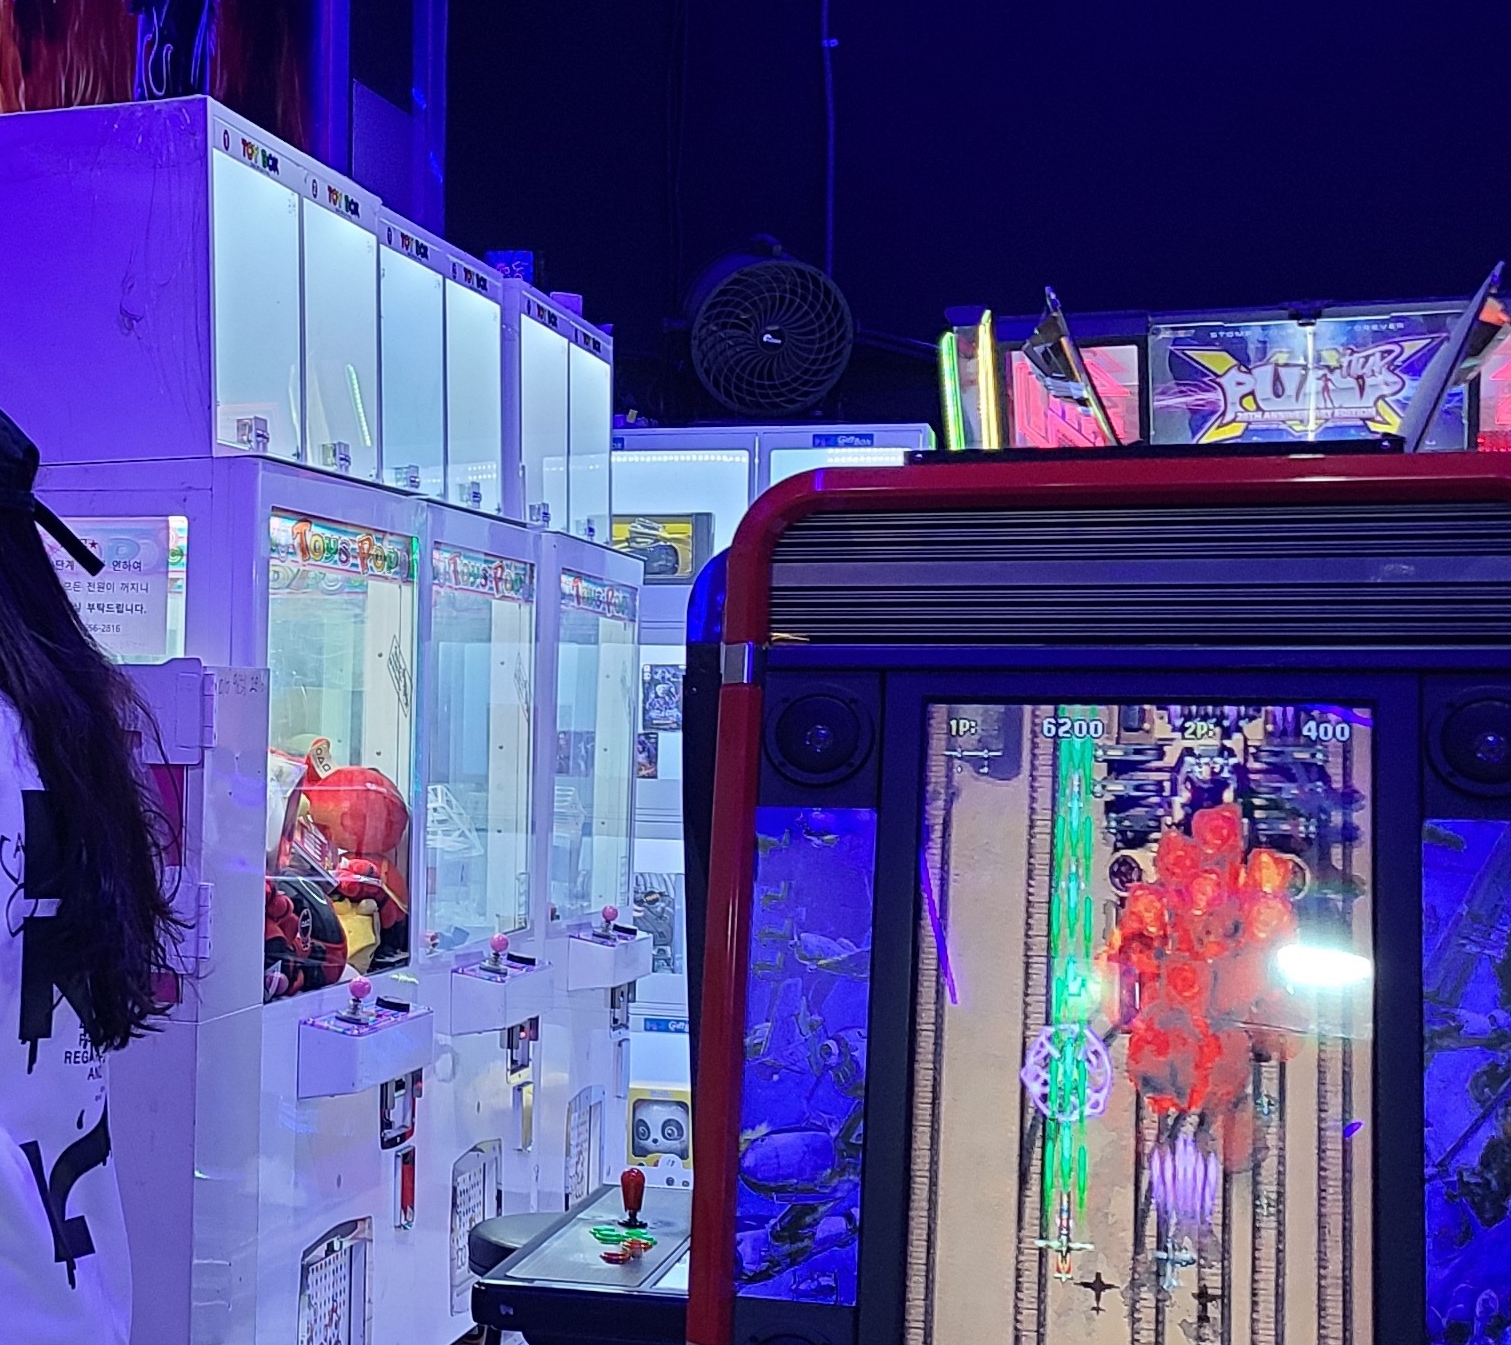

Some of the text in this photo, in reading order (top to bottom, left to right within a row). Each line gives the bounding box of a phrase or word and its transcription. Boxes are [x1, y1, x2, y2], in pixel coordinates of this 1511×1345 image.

[241, 137, 259, 164] TOY
[261, 149, 280, 175] BOX
[327, 185, 343, 208] TOY
[344, 194, 361, 219] BOX
[292, 519, 352, 567] Toys
[87, 602, 147, 615] 부탁드립니다.
[1042, 717, 1104, 739] 6200
[1302, 722, 1351, 741] 400
